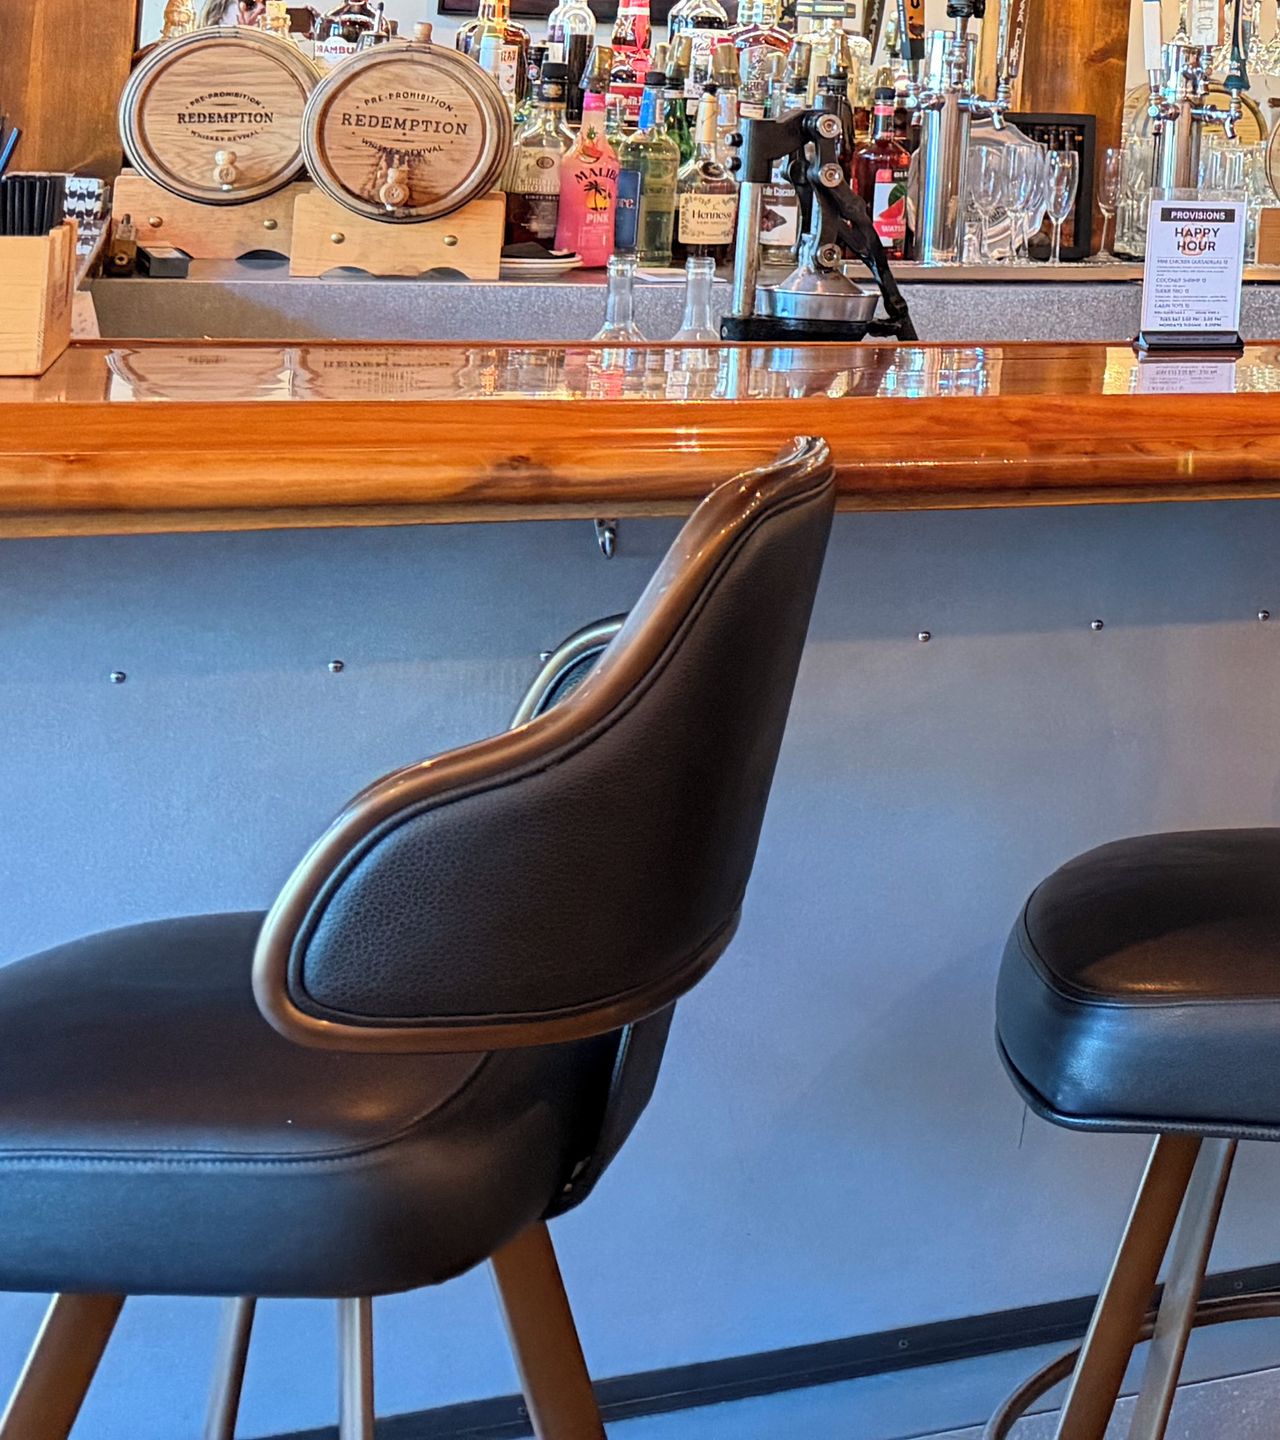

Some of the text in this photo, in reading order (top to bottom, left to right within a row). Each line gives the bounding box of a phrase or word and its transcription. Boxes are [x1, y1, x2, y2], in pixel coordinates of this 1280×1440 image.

[315, 43, 356, 56] DRAMBU
[190, 91, 261, 106] PRE-PROHIBITION
[364, 92, 454, 112] PRE-PROHIBITION
[177, 112, 274, 125] REDEMPTION
[341, 112, 469, 136] REDEMPTION
[191, 130, 260, 142] WHISKEY REVIVAL
[361, 137, 445, 157] WHISKEY REVIVAL
[574, 166, 620, 185] MALIB
[586, 213, 609, 223] PINK
[1171, 211, 1226, 220] PROVISIONS
[1175, 227, 1220, 238] HAPPY
[1177, 241, 1216, 252] HOUR
